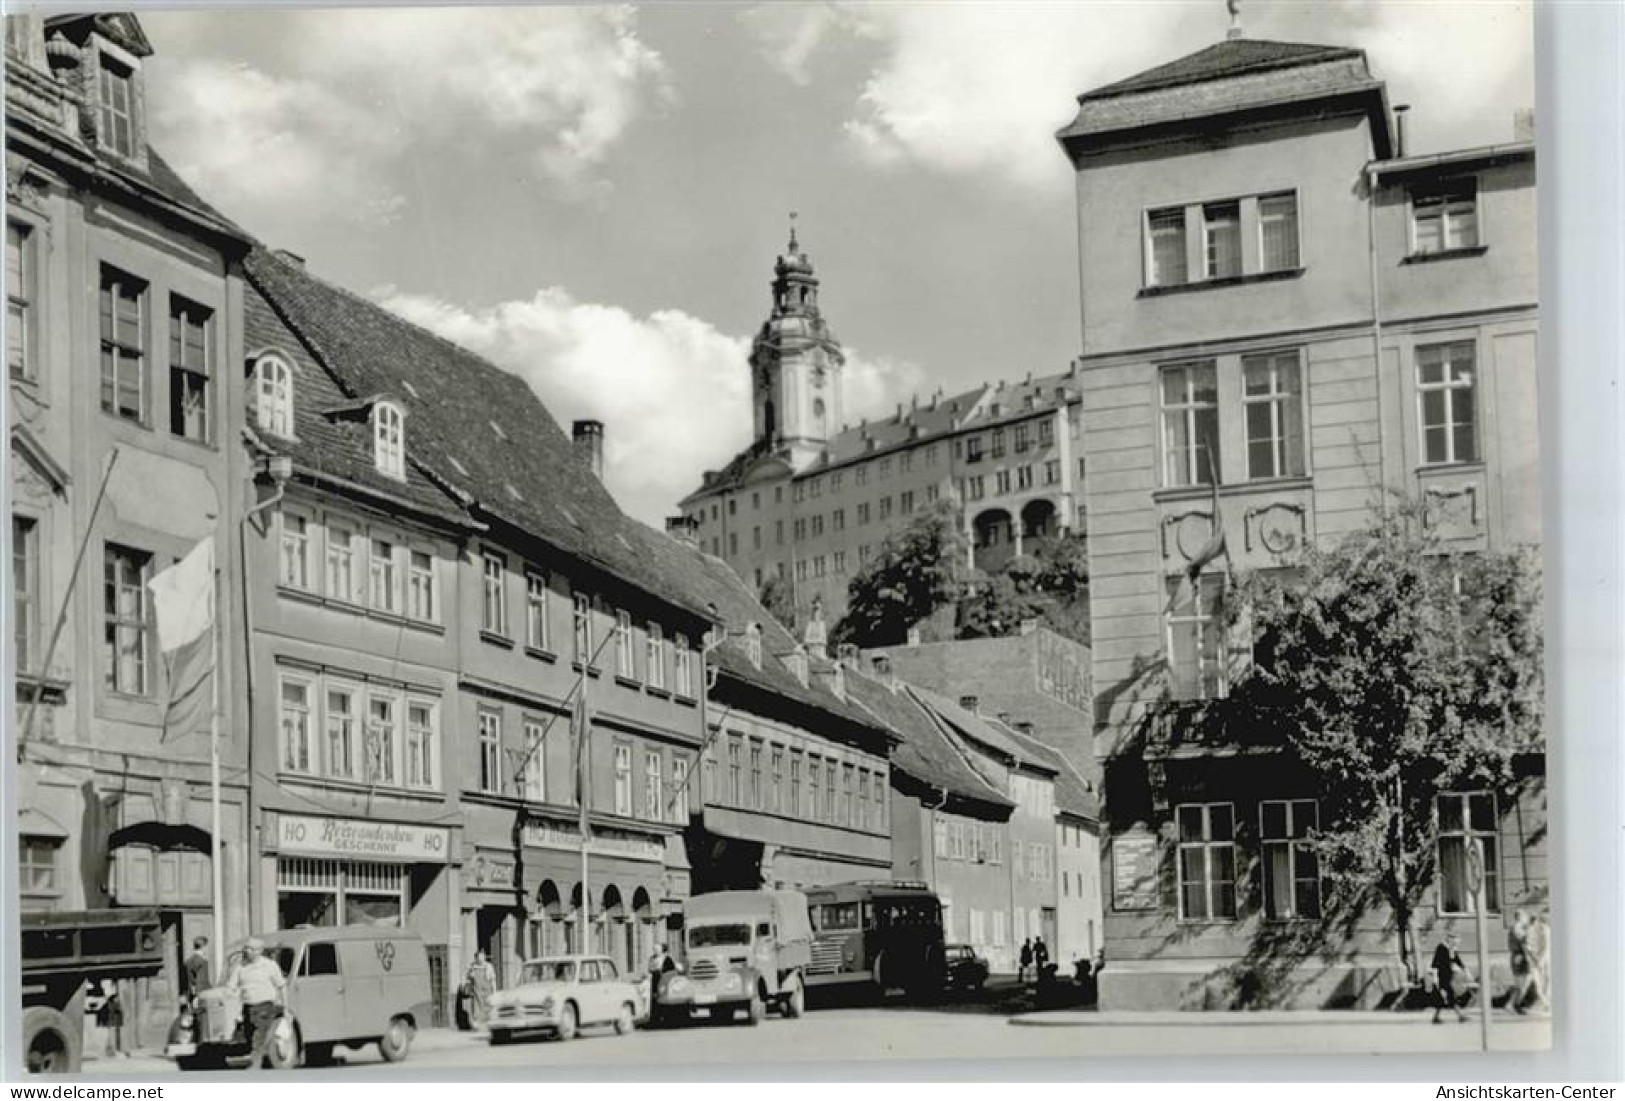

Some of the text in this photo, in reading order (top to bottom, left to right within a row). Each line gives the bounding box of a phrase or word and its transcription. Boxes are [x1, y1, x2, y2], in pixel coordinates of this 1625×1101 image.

[285, 821, 307, 842] HO
[423, 832, 444, 852] HO
[333, 839, 398, 852] GESCHENKE
